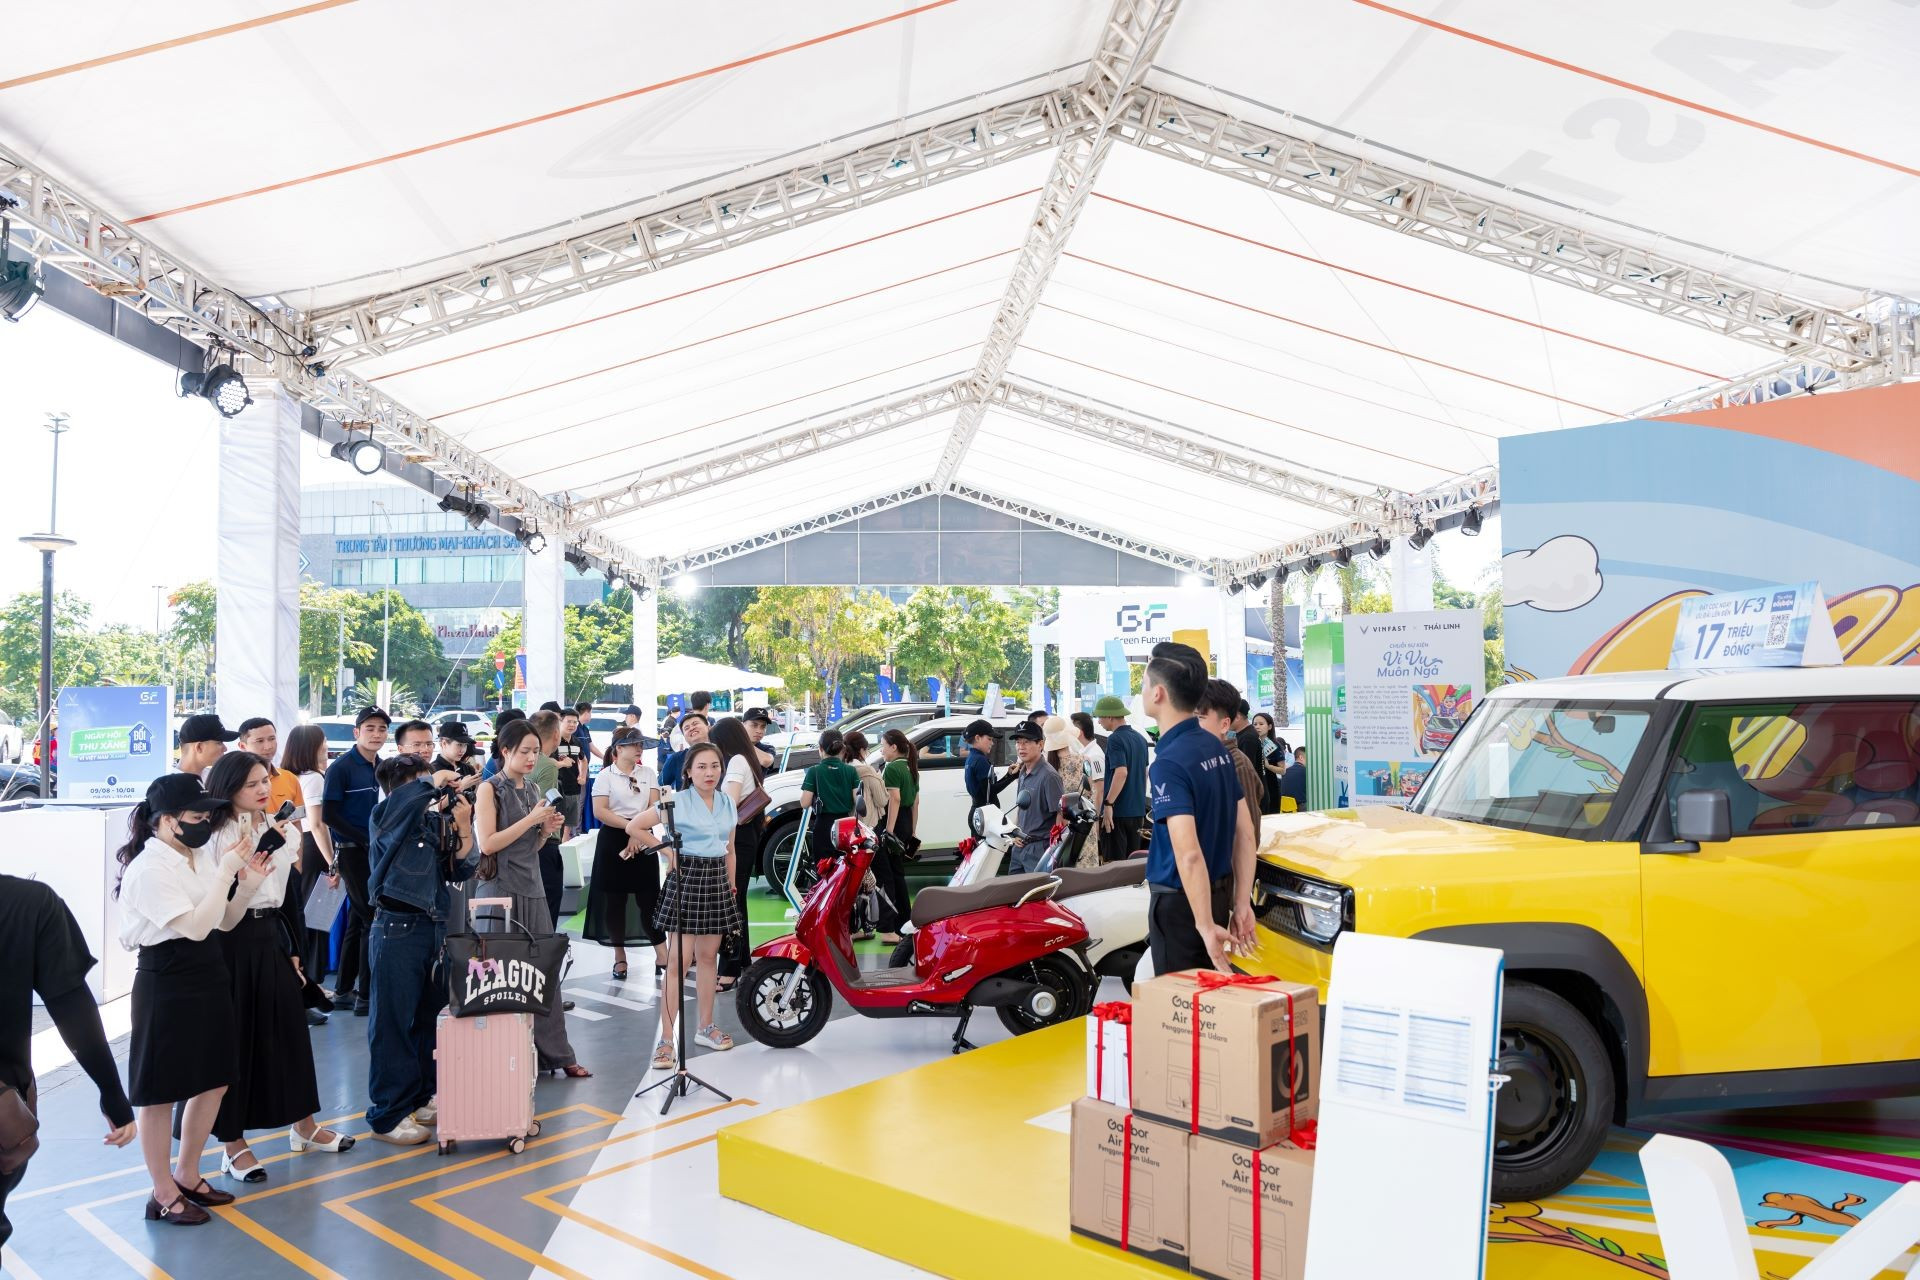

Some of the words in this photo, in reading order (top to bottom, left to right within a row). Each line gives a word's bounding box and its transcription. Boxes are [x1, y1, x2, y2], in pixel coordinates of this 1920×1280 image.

[336, 539, 369, 553] TRUNG
[1116, 603, 1168, 632] GF
[1424, 621, 1441, 631] THÁI
[1694, 623, 1725, 660] 17
[1727, 623, 1753, 641] TRIỆU
[1383, 650, 1402, 667] Vi
[1405, 649, 1443, 668] Vu
[1377, 666, 1410, 678] Muôn
[1414, 664, 1439, 679] Ngả
[140, 691, 158, 702] GF
[79, 742, 98, 751] THU
[100, 739, 127, 750] XĂNG
[464, 959, 546, 1006] LEAGUE
[483, 991, 527, 1006] SPOILED
[1172, 1011, 1188, 1024] Air
[1107, 1118, 1149, 1139] Gabor
[1107, 1133, 1123, 1147] Air
[1232, 1152, 1280, 1176] Gabor
[1232, 1169, 1250, 1183] Air
